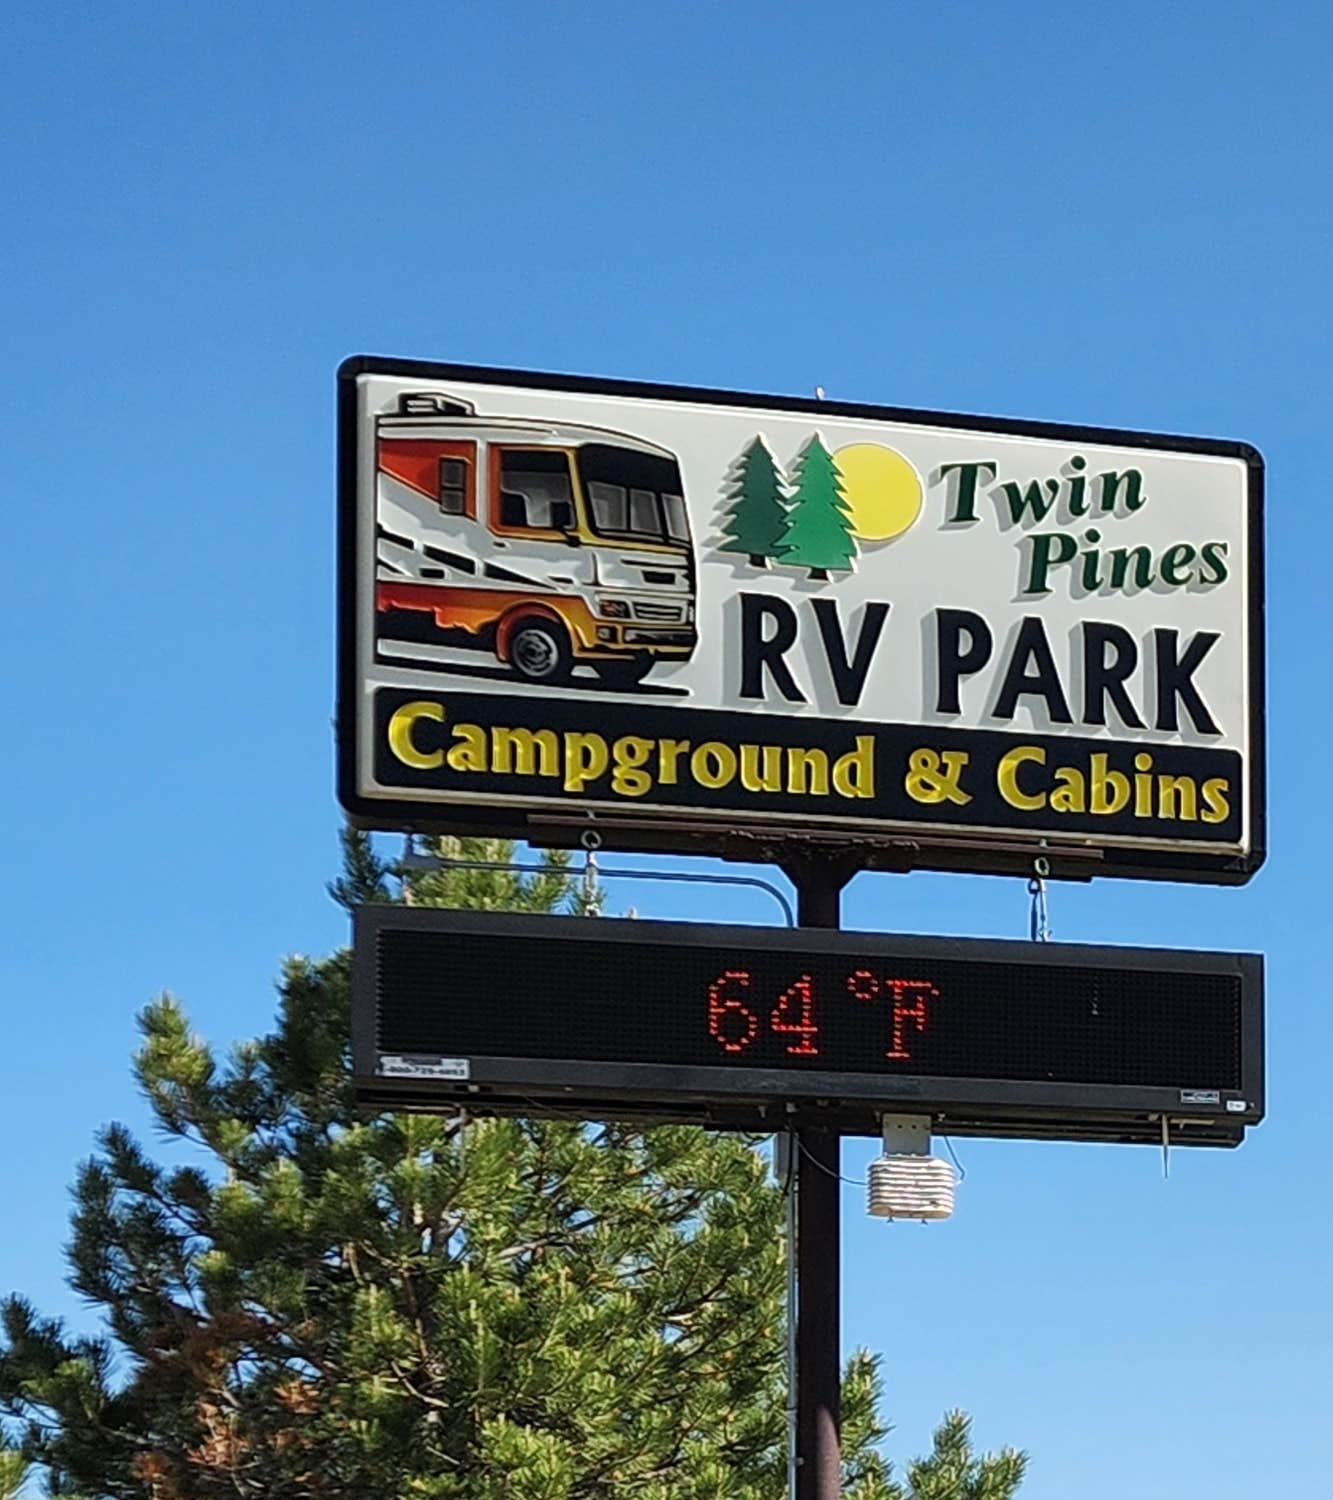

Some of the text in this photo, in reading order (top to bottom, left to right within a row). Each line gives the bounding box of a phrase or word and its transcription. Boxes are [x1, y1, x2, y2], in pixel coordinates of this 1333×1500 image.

[939, 455, 1147, 525] Twin
[1022, 528, 1229, 595] Pines
[738, 591, 1225, 737] RV PARK
[387, 701, 1231, 824] Campground & Cabins
[707, 970, 819, 1055] 64
